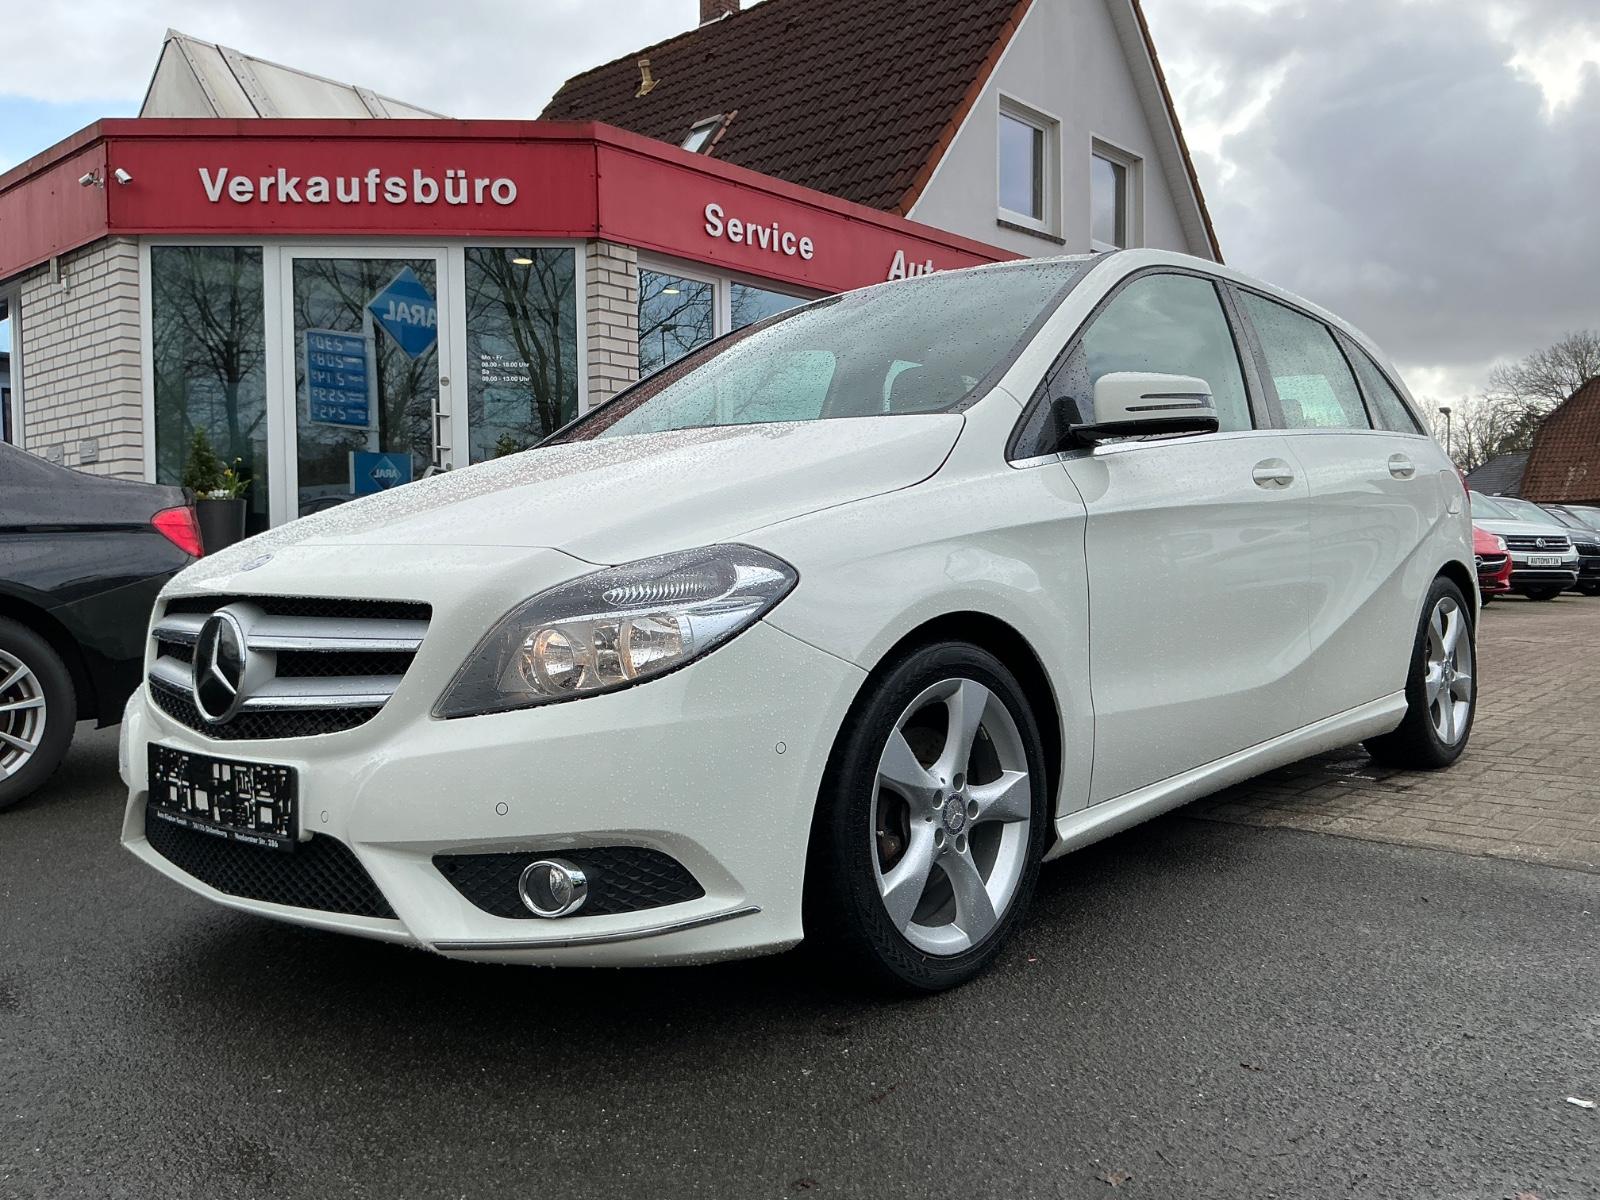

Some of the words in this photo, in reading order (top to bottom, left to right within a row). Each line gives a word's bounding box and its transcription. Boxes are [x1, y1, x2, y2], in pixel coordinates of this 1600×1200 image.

[198, 167, 518, 205] Verkaufsbüro
[704, 203, 814, 260] Service
[887, 249, 944, 281] Aut
